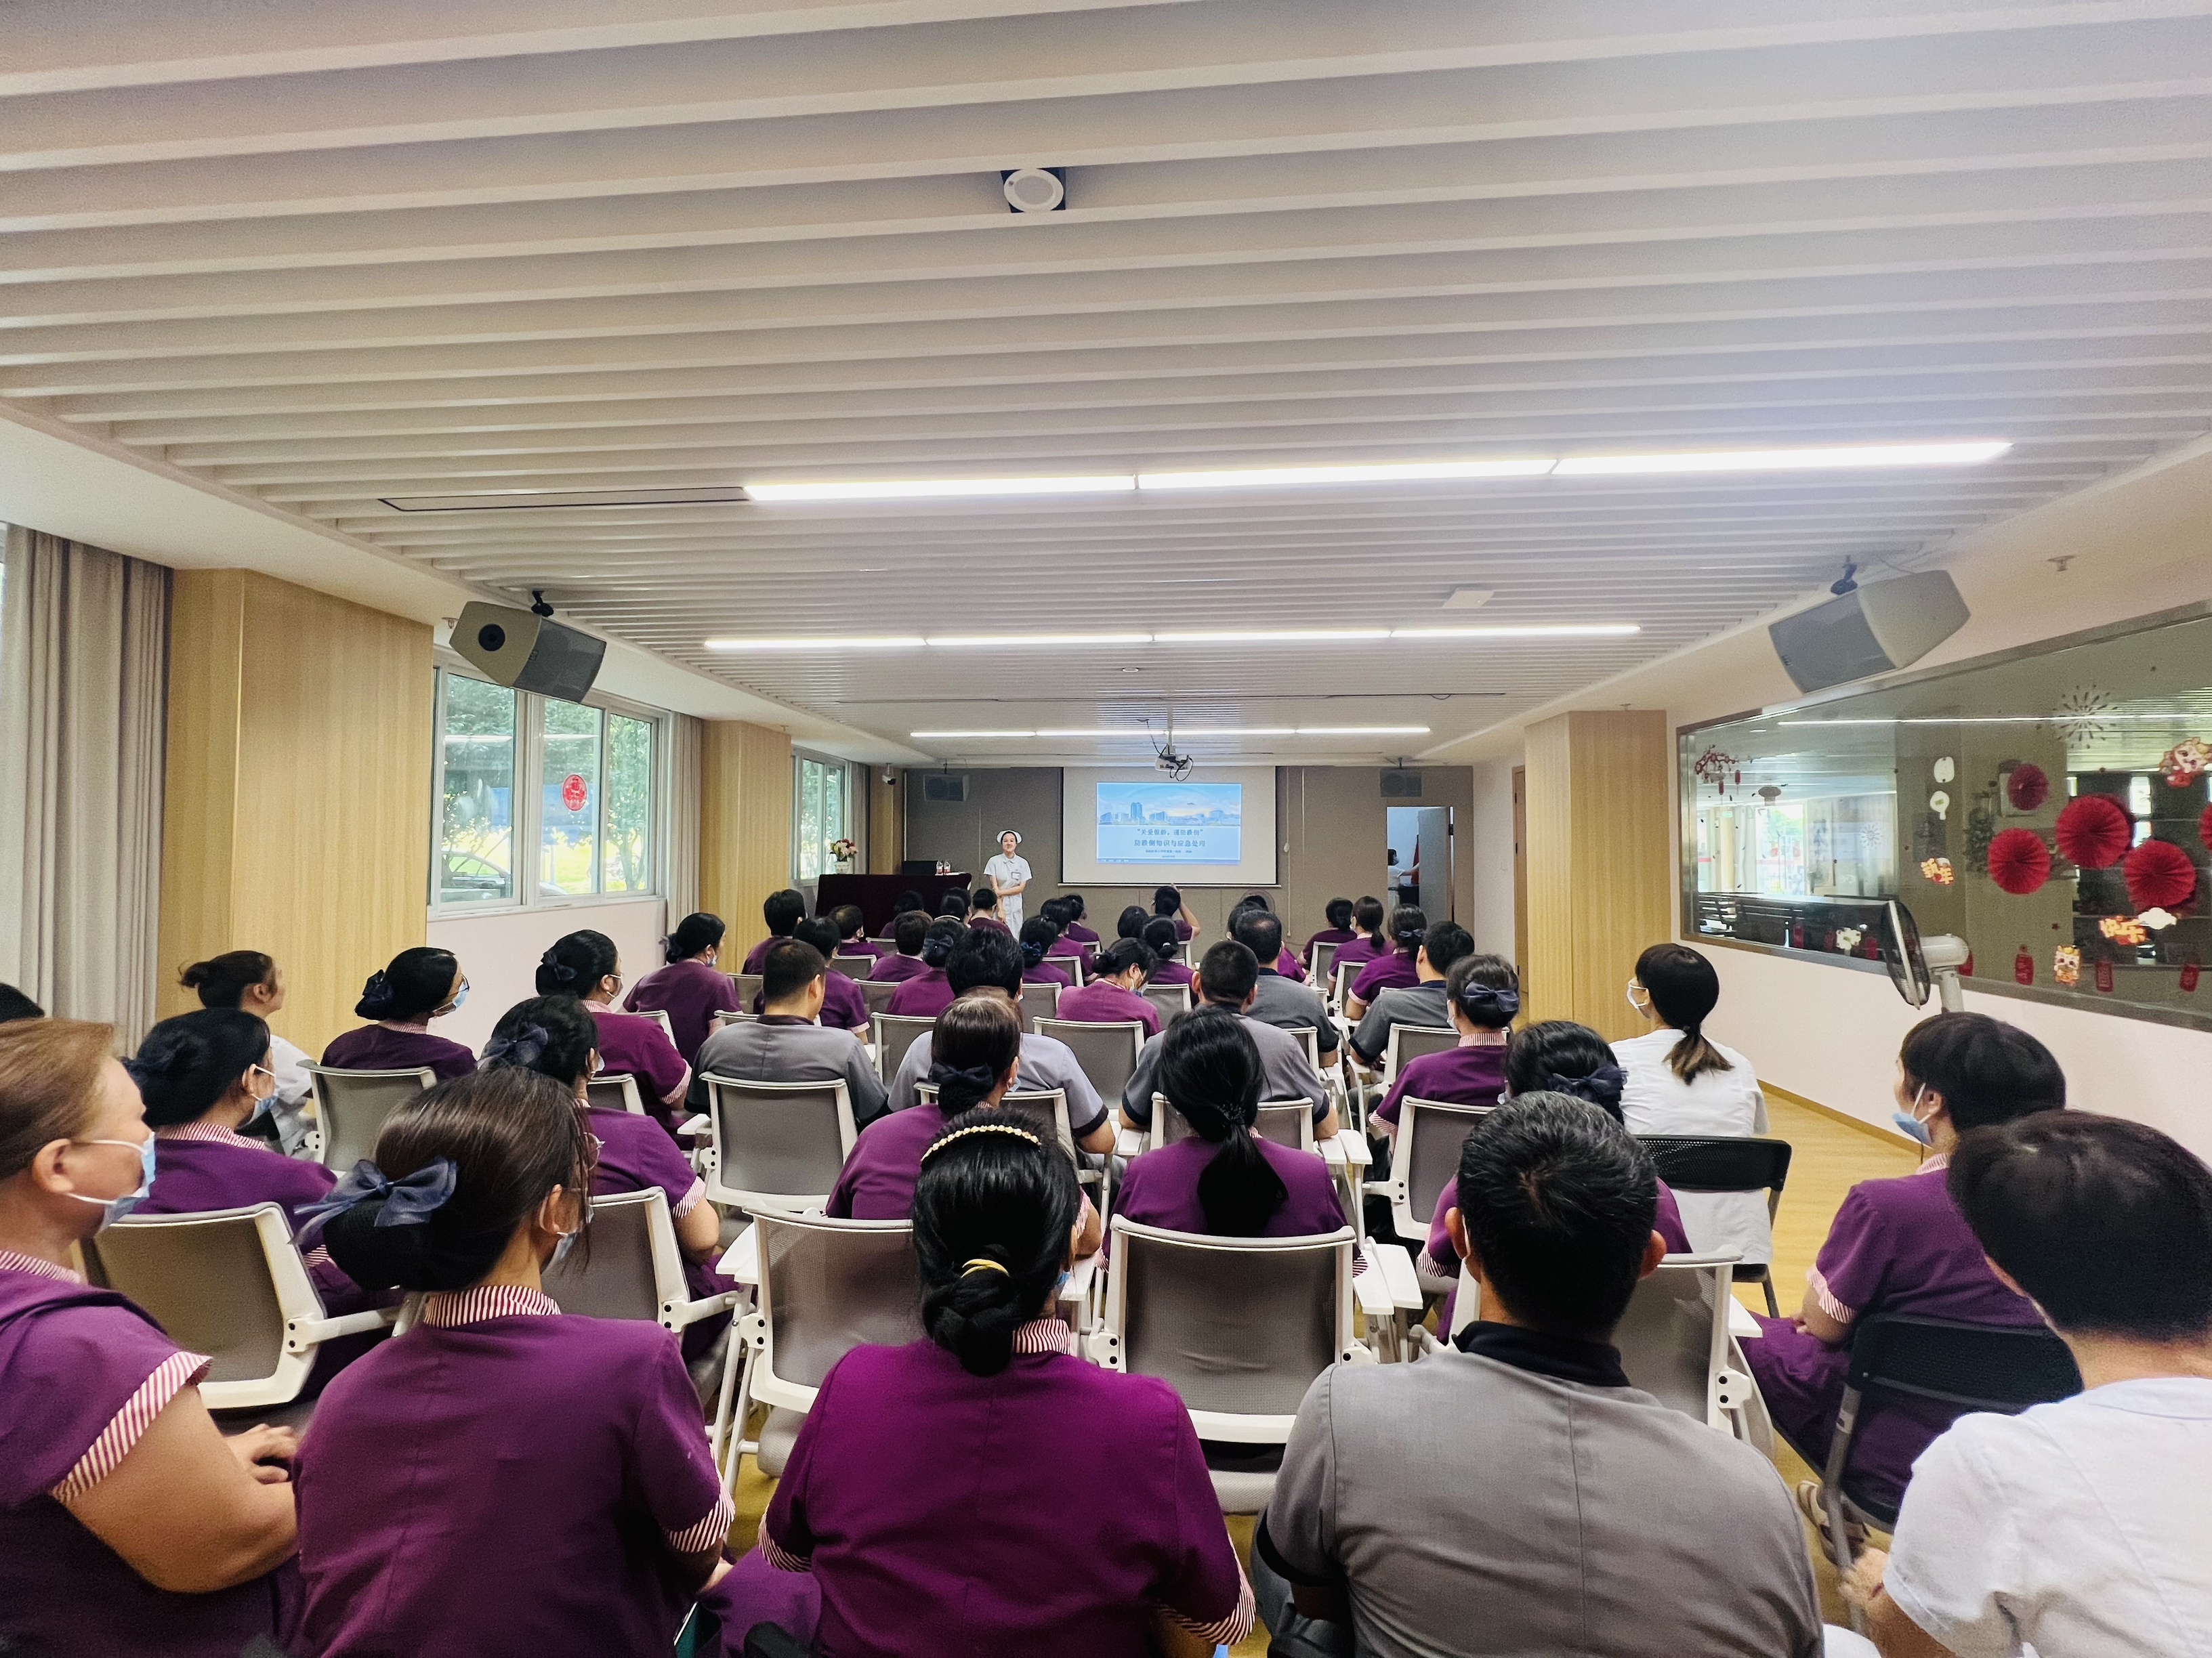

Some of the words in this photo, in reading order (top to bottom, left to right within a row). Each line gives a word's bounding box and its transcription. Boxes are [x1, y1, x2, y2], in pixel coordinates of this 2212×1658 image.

[1134, 839, 1206, 847] 防跌倒知识与应急处理
